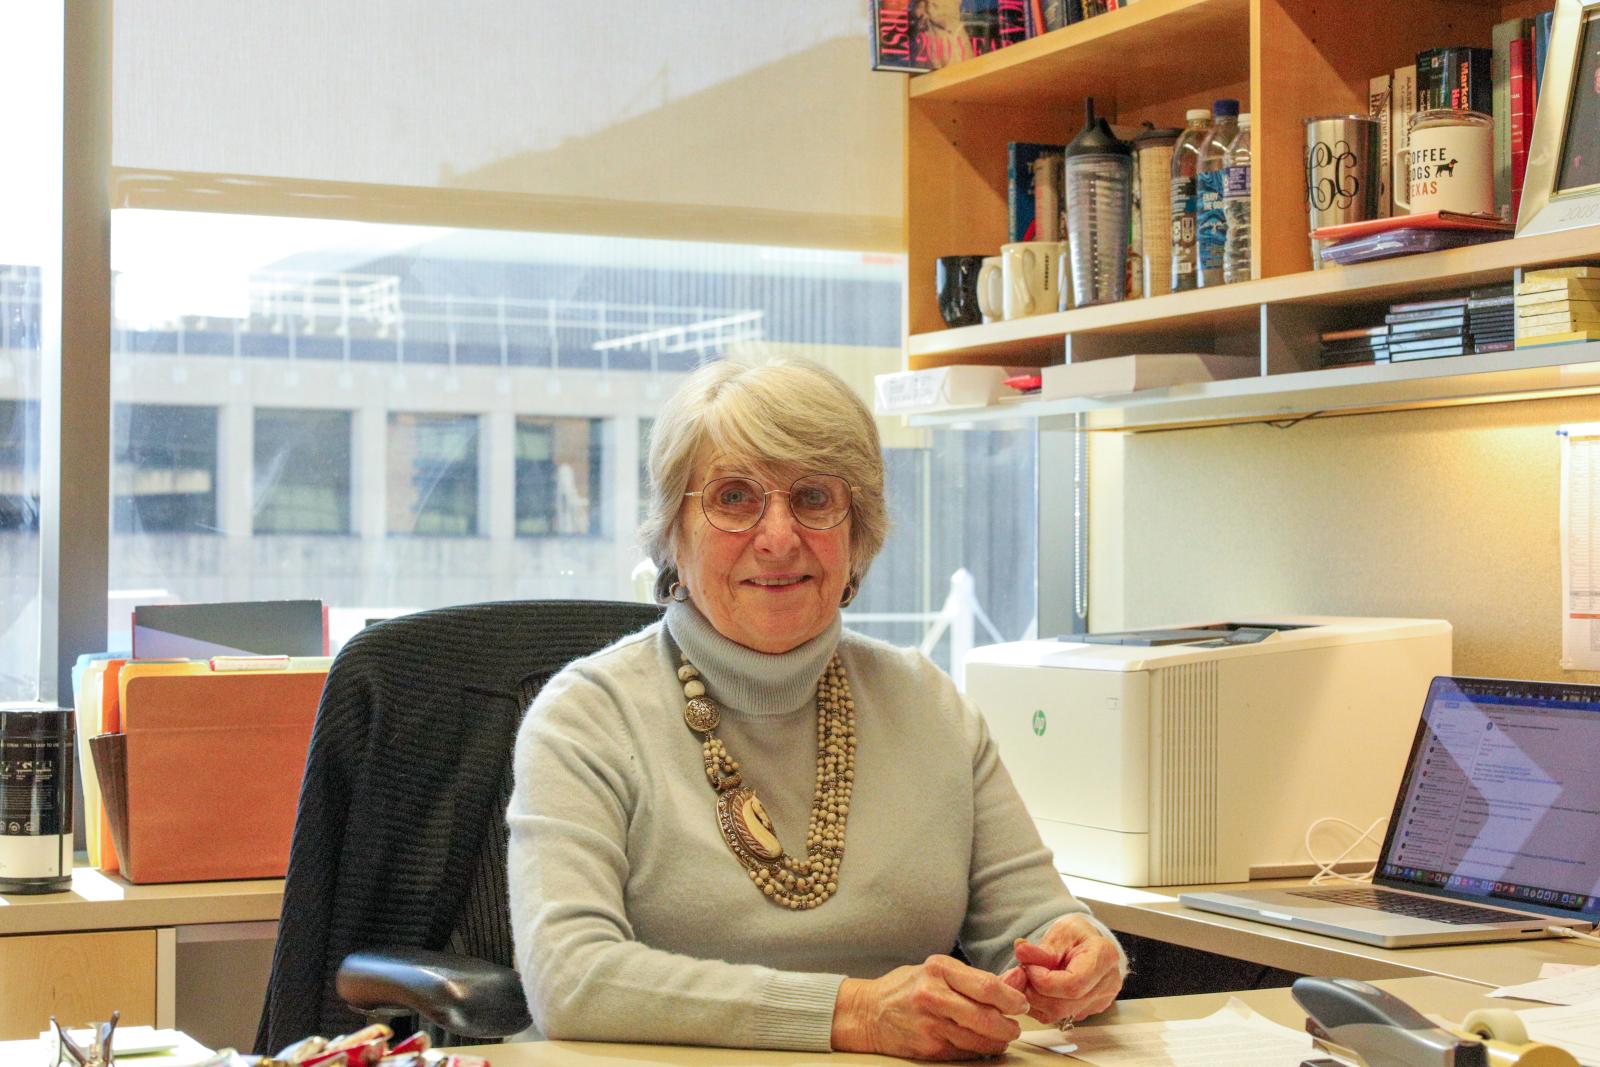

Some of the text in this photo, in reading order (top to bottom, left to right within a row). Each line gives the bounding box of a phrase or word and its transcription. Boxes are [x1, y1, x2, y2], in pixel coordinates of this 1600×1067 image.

[1410, 147, 1447, 165] OFFEE
[1410, 165, 1431, 181] OGS
[1410, 180, 1438, 197] EXAS
